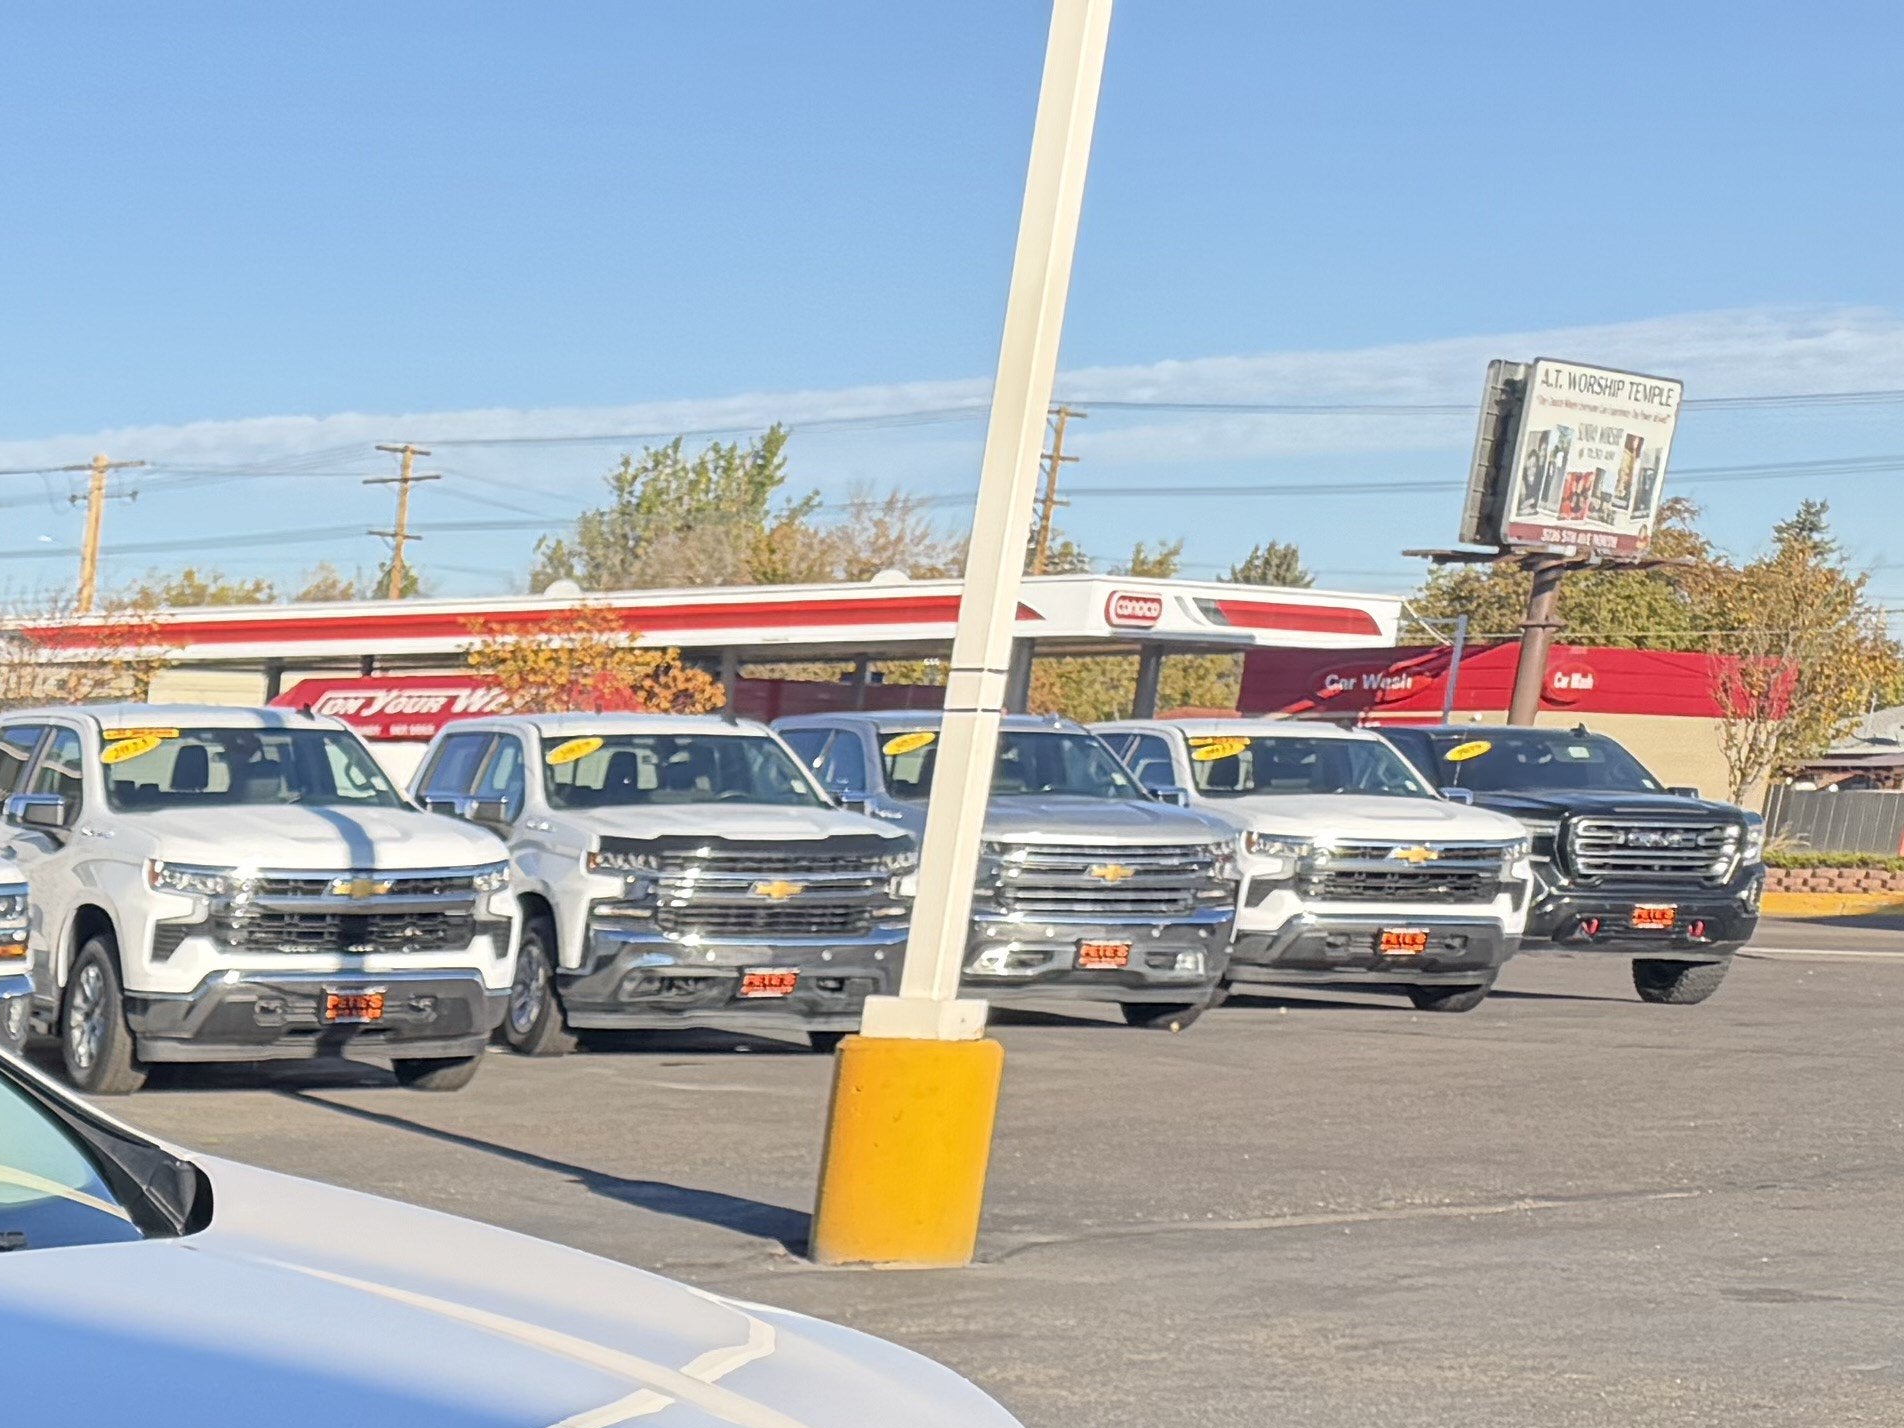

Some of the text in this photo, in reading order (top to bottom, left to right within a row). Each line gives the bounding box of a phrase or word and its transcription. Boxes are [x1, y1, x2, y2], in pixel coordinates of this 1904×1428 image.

[1568, 372, 1625, 398] WORSHIP
[1628, 381, 1675, 407] TEMPLE
[1325, 673, 1413, 691] Car Wash
[1553, 671, 1570, 689] Car
